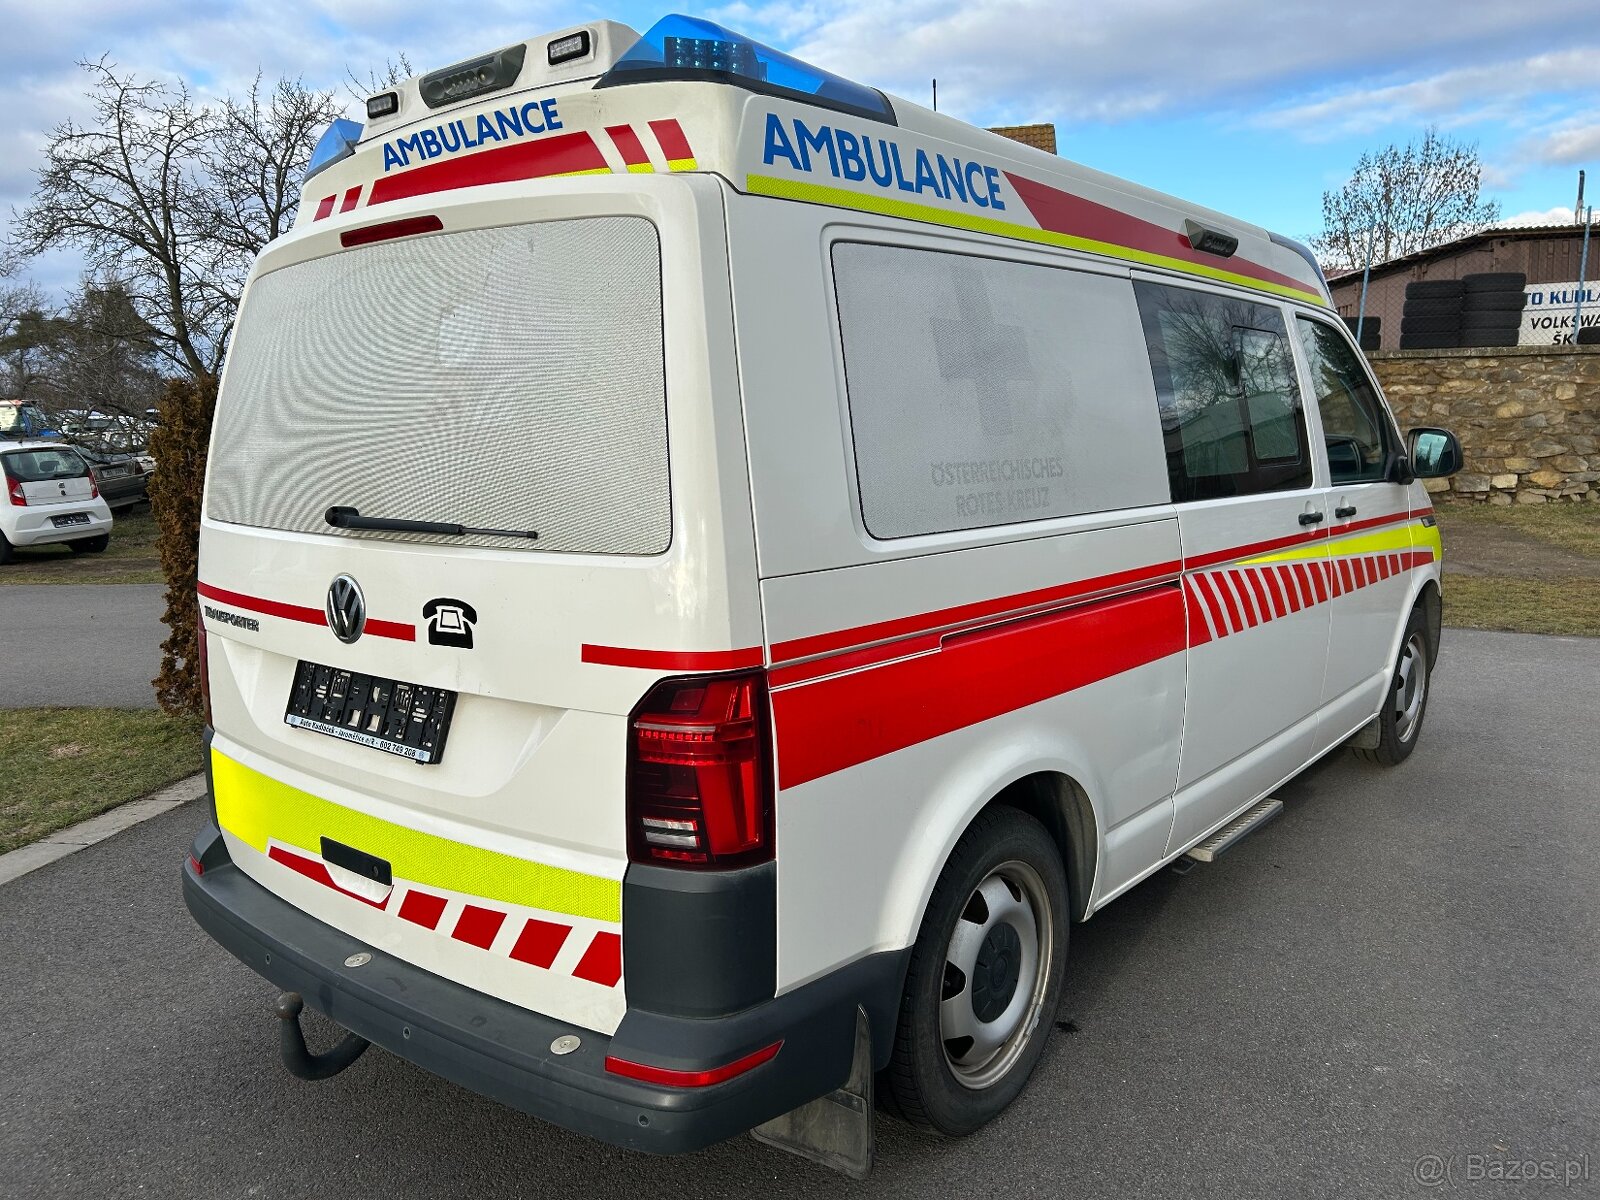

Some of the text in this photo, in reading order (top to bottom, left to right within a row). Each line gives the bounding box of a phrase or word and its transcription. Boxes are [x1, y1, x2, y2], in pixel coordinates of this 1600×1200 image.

[384, 97, 563, 172] AMBULANCE
[763, 112, 1006, 210] AMBULANCE
[1549, 289, 1600, 304] KUDL
[930, 456, 1063, 487] ÖSTERREICHISCHES
[955, 486, 1050, 518] ROTES KREUZ
[204, 605, 260, 632] TRANSPORTER
